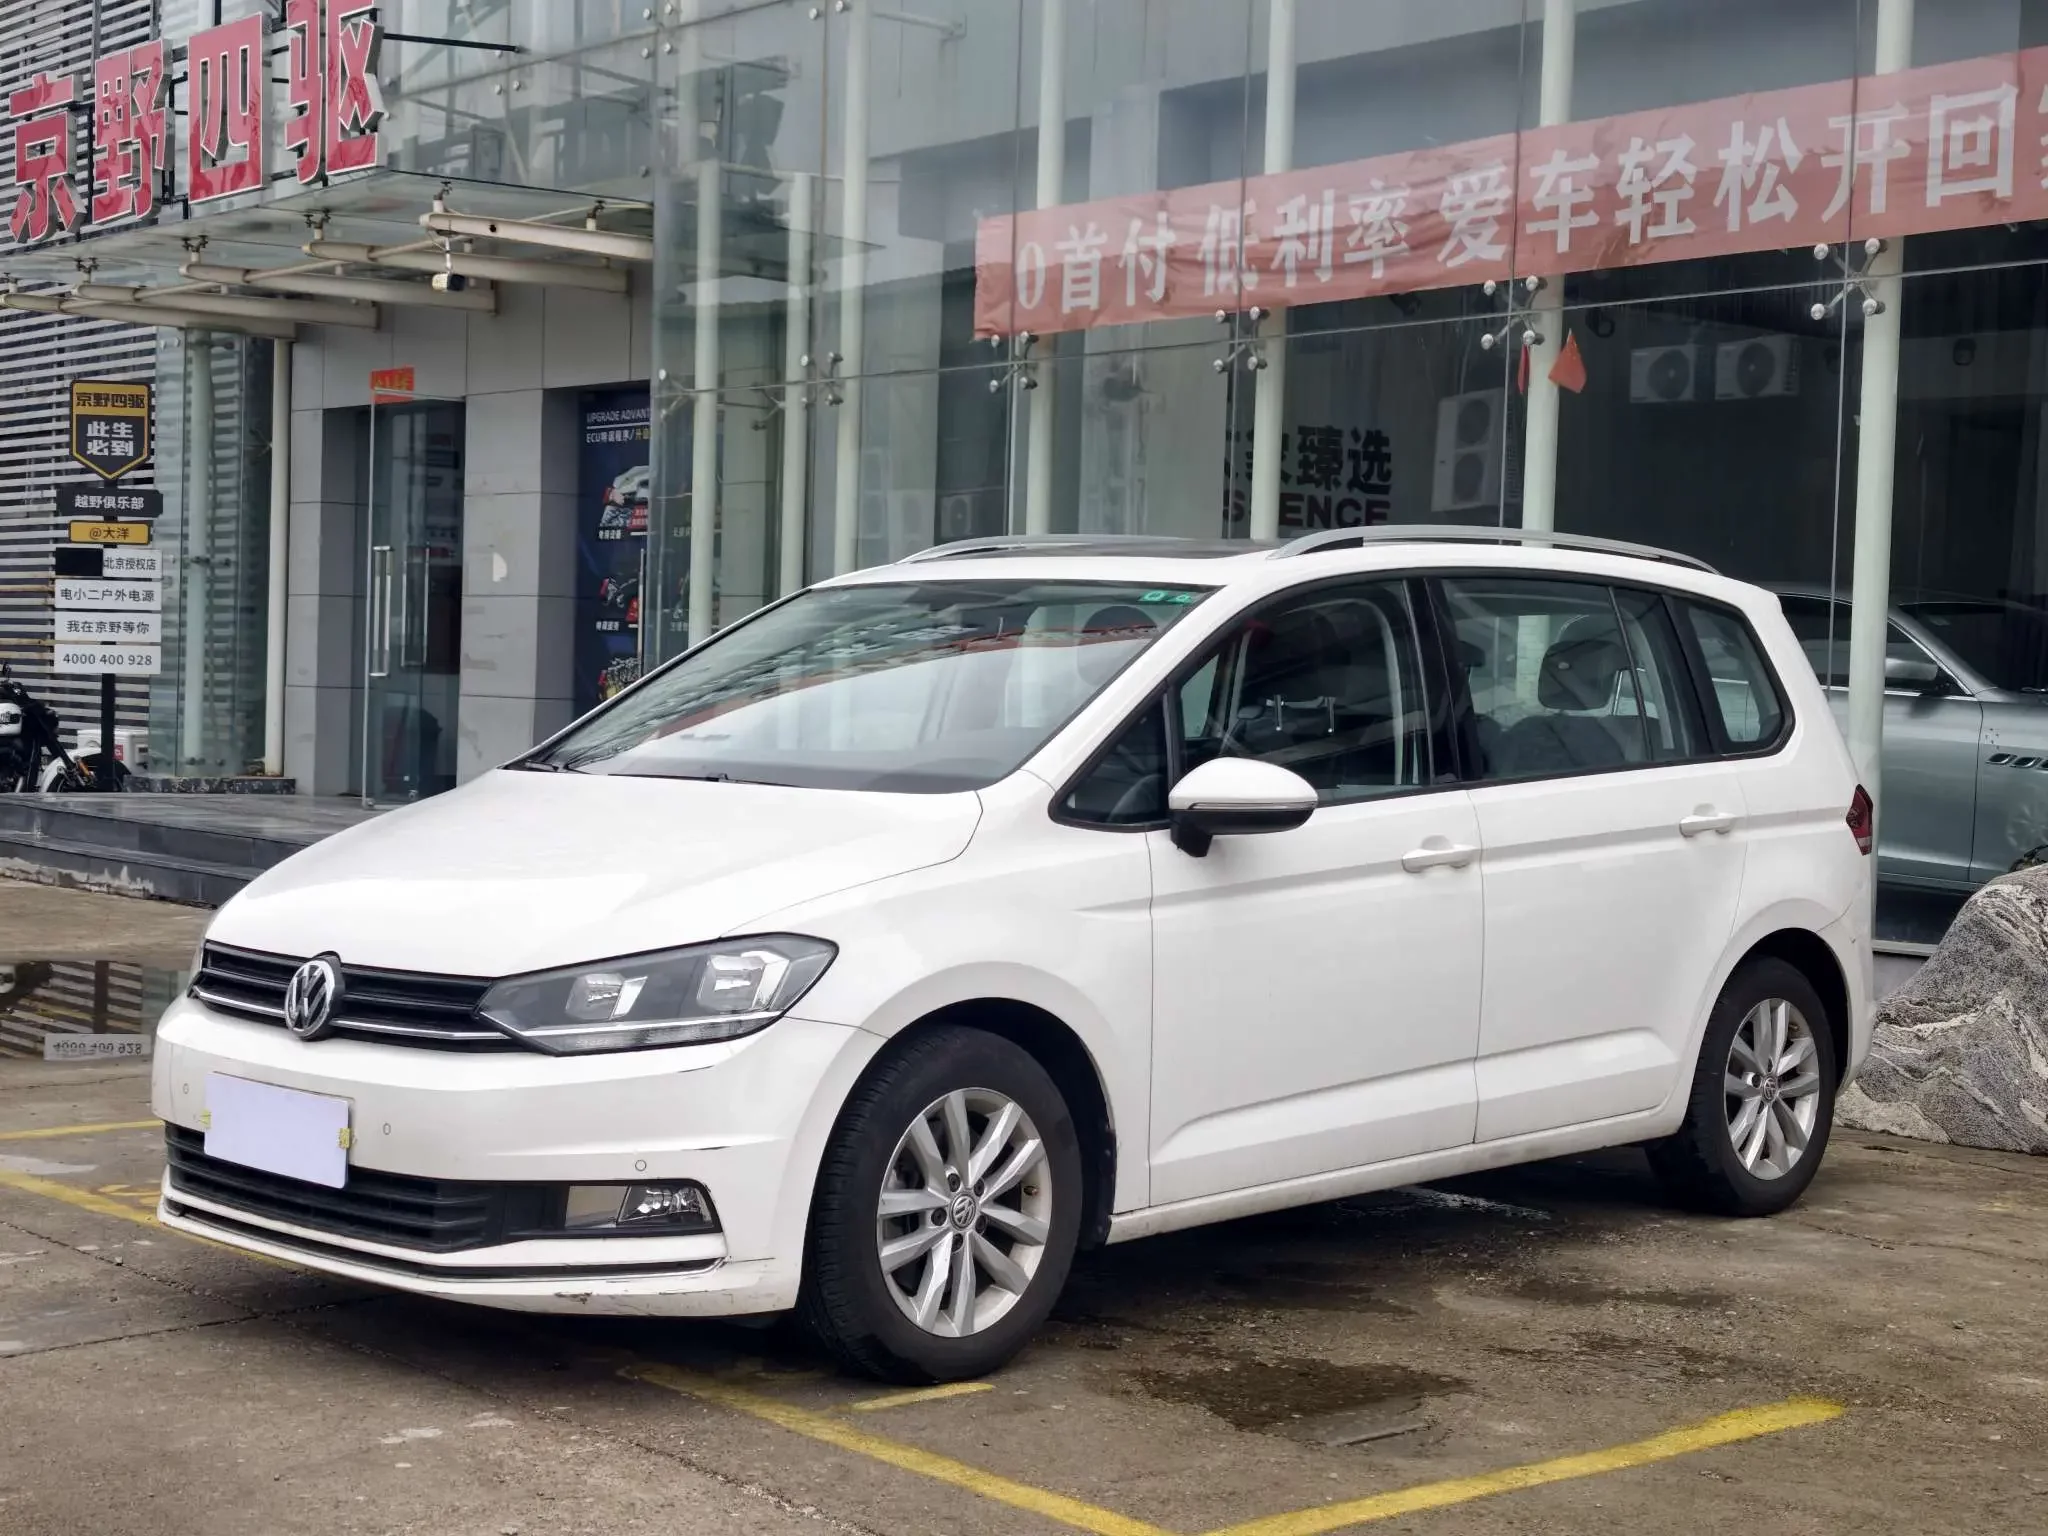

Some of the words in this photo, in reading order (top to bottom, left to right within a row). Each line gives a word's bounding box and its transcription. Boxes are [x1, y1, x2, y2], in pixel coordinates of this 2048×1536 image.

[8, 0, 378, 241] 京野四驱
[1438, 82, 2048, 268] 爱车轻松开回
[76, 392, 146, 409] 京野四驱
[87, 421, 133, 438] 此生
[87, 439, 133, 457] 必到
[75, 494, 144, 510] 越野俱乐部
[89, 526, 130, 540] @大洋
[103, 557, 157, 572] 北京授权店
[60, 588, 155, 603] 电小二户外电源
[67, 620, 150, 635] 我在京野等你
[63, 653, 96, 665] 4000
[100, 654, 124, 665] 400
[128, 654, 153, 666] 928
